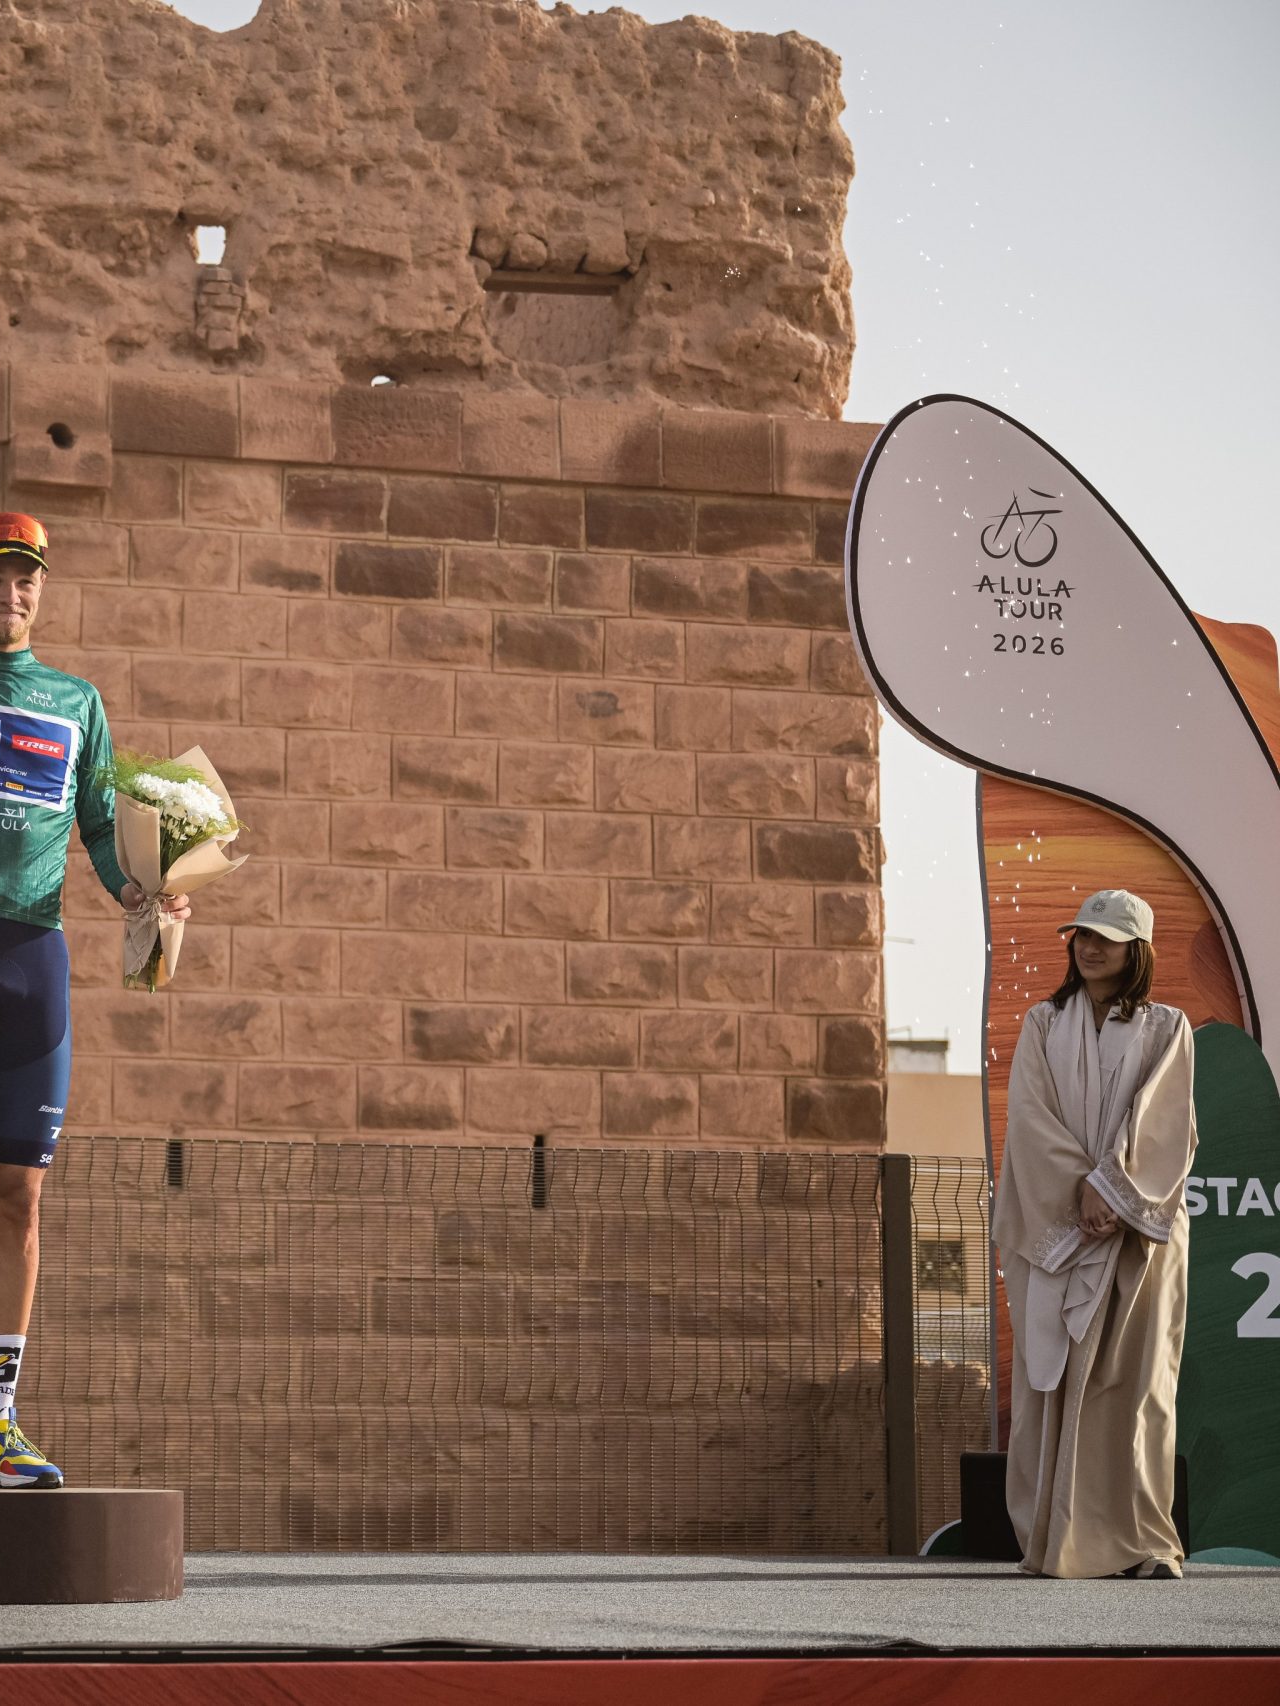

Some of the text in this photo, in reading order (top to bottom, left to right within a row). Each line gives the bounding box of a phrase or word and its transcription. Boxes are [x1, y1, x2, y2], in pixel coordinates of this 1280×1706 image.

[973, 575, 1075, 598] ALULA
[994, 598, 1062, 620] TOUR
[993, 633, 1065, 655] 2026
[25, 696, 58, 709] ALULA
[17, 739, 60, 754] TREK
[1184, 1176, 1280, 1217] STA
